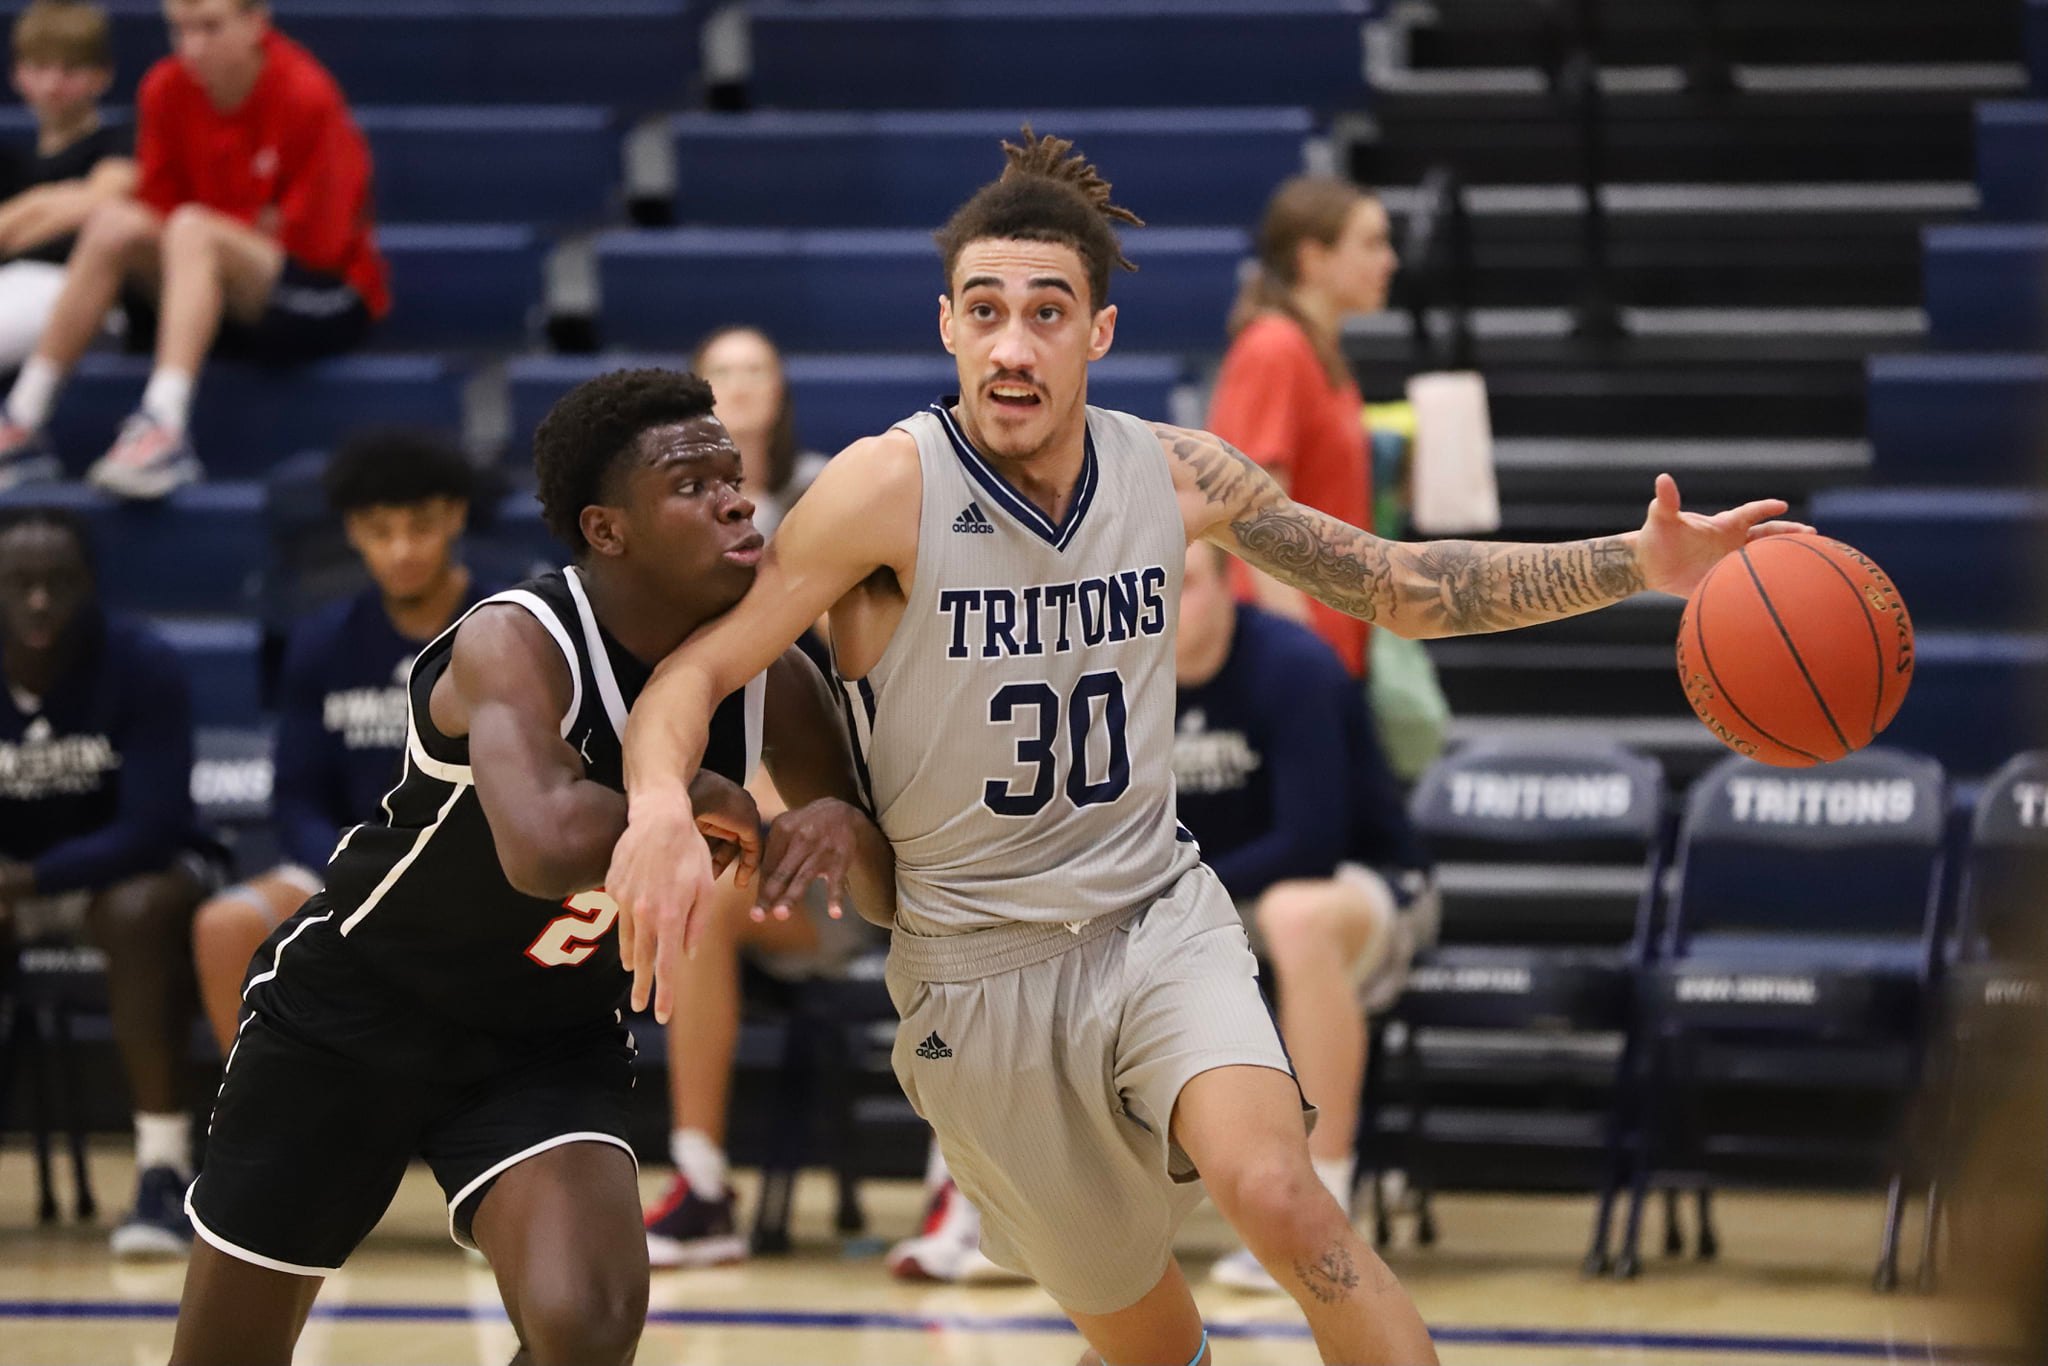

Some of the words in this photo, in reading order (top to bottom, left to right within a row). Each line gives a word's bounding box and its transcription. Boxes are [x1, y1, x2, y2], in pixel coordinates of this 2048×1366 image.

[952, 522, 994, 534] adidas
[937, 566, 1167, 660] TRITONS
[981, 668, 1132, 818] 30
[1449, 771, 1632, 820] TRITONS
[1727, 776, 1914, 825] TRITONS
[523, 886, 620, 969] 2
[915, 1047, 953, 1060] addas
